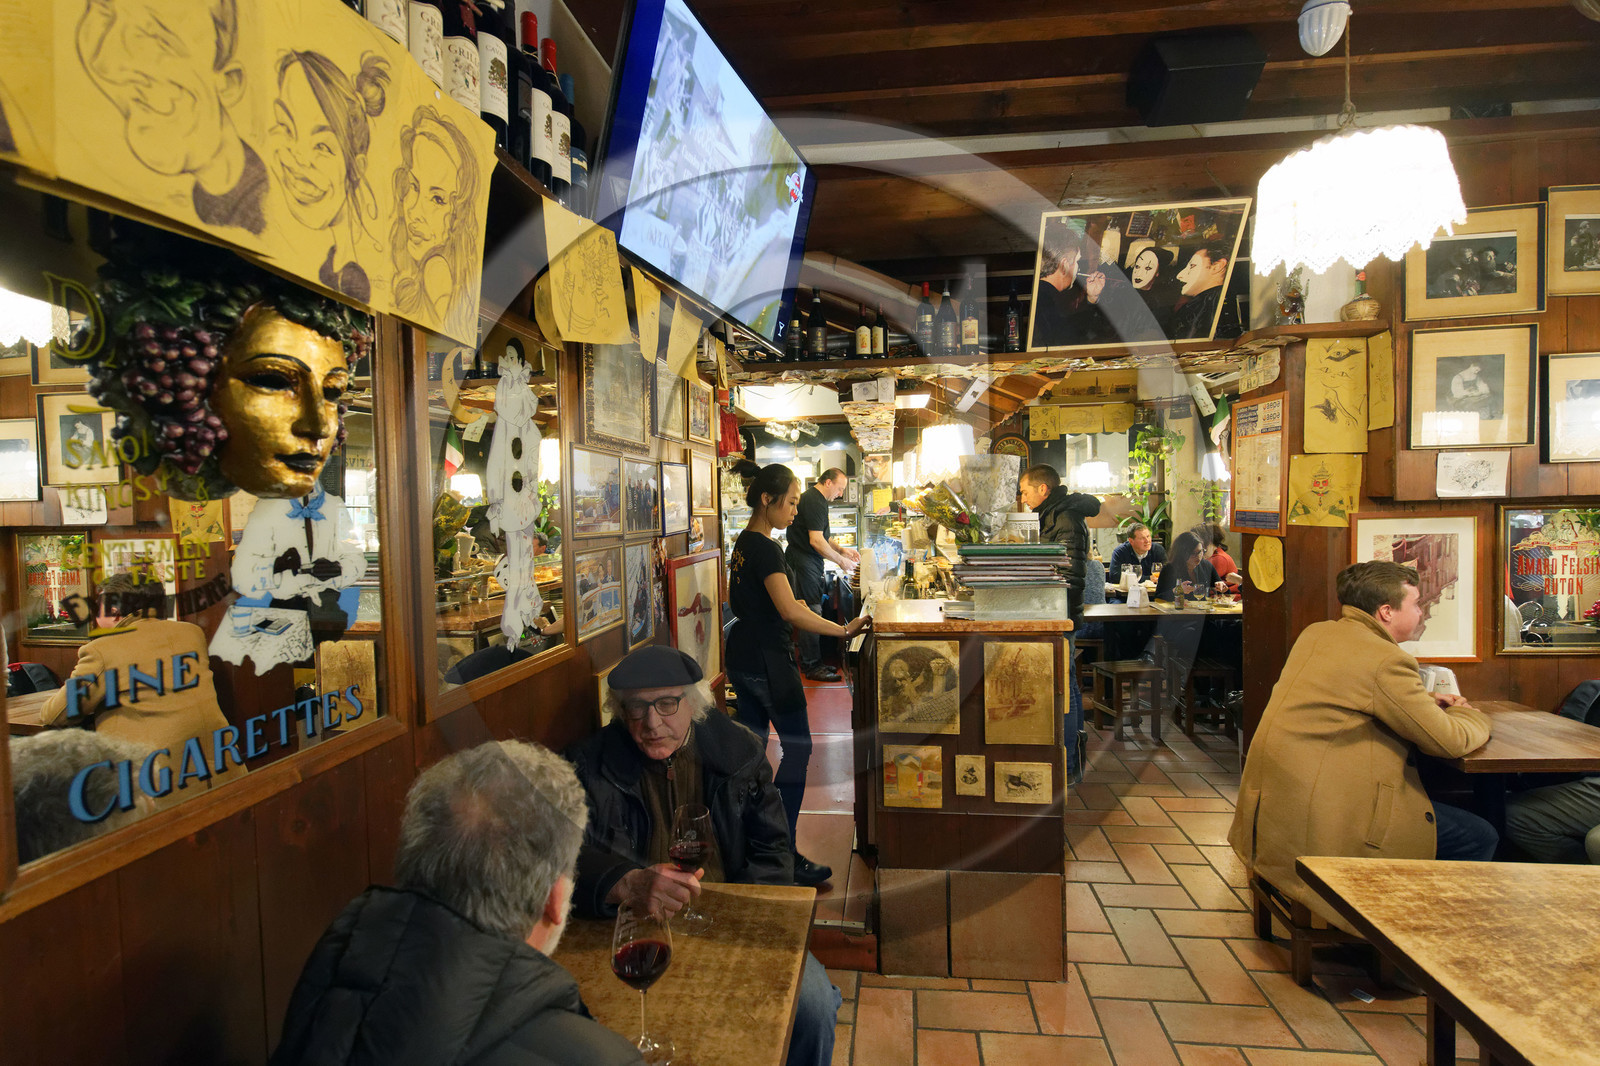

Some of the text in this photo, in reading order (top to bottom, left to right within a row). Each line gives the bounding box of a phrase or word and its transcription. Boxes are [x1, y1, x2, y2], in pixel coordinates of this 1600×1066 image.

[61, 537, 212, 570] GENTLEMEN
[1517, 554, 1558, 576] AMARO
[127, 559, 207, 587] TASTE
[1543, 577, 1584, 596] BUTON
[65, 651, 200, 720] FINE
[68, 683, 364, 824] CIGARETTES
